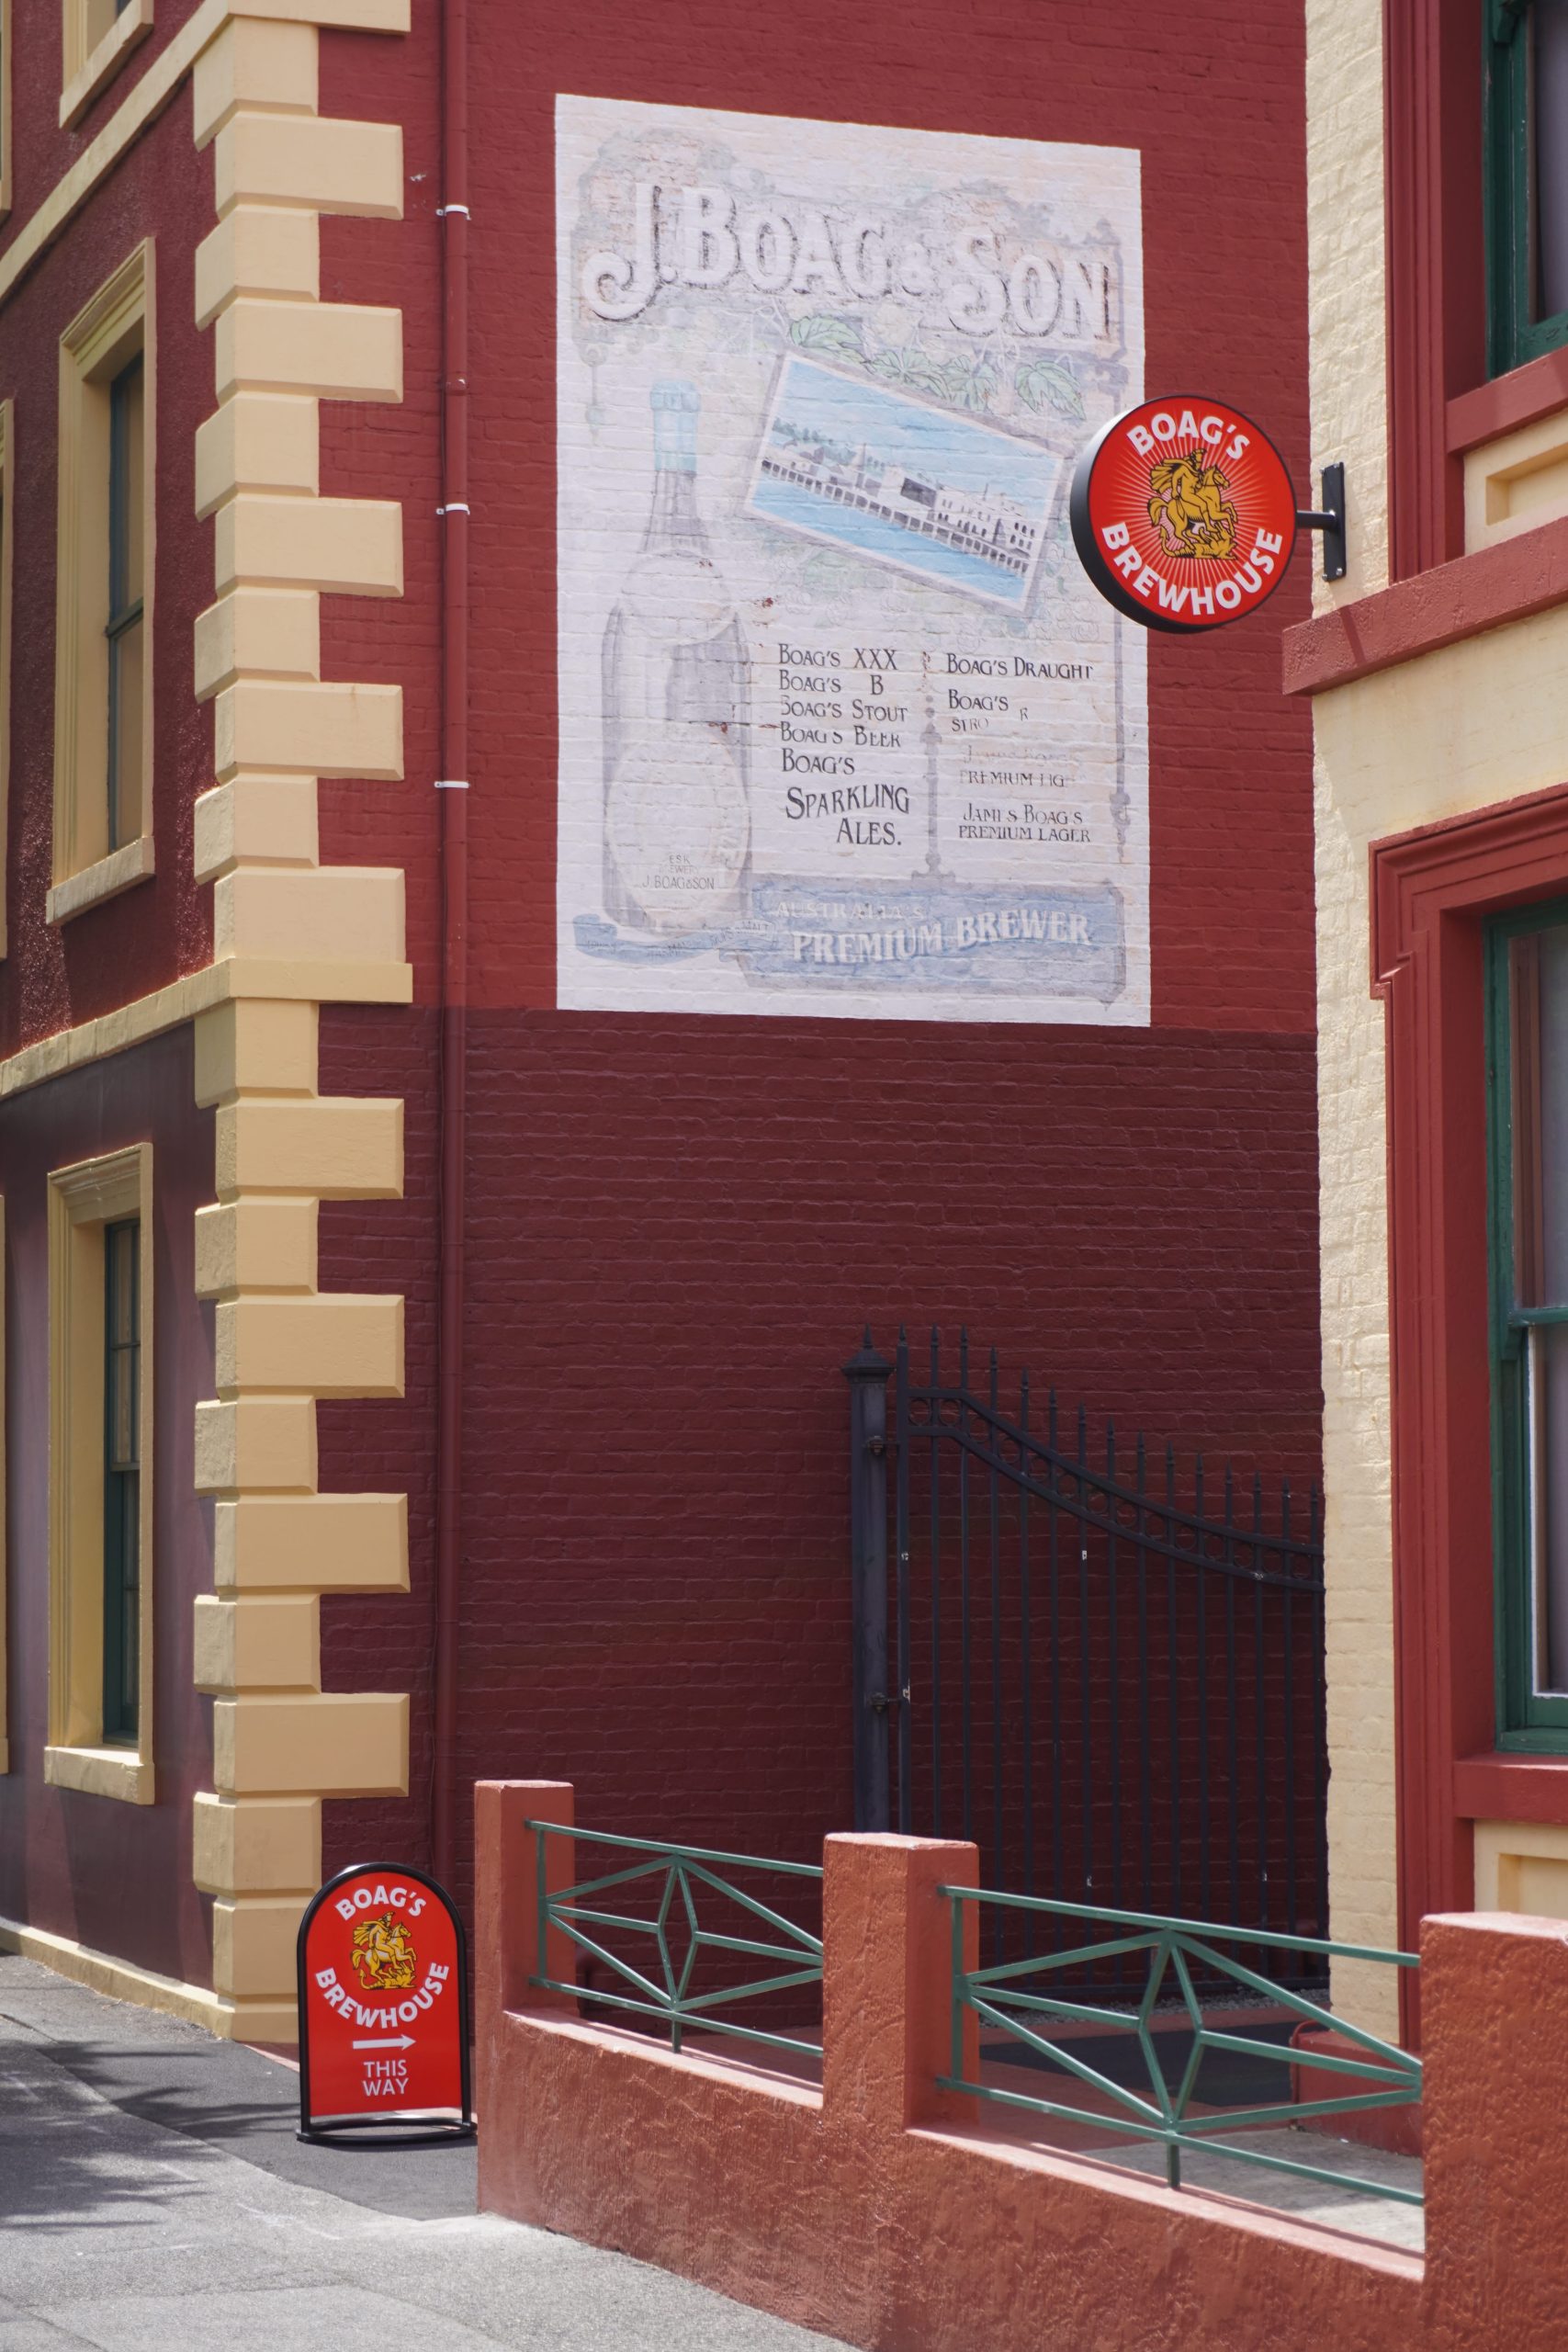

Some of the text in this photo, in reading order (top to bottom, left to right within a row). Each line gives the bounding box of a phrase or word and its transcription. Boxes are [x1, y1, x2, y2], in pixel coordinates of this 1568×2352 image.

[680, 186, 891, 300] BOAG
[895, 242, 931, 298] &
[946, 227, 1110, 338] SON
[1126, 411, 1250, 459] BOAG'S
[1102, 522, 1282, 615] BREWHOUSE
[779, 643, 898, 670] BOAG'S XXX
[947, 653, 1093, 679] BOAG'S DRAUGHT
[779, 670, 884, 695] BOAG'S B
[852, 699, 908, 722] STOUT
[948, 689, 1009, 711] BOAG'S
[854, 725, 901, 747] BEER
[782, 748, 855, 775] BOAG'S
[786, 784, 909, 820] SPARKLING
[837, 818, 902, 845] ALES.
[958, 825, 1091, 842] PREMIUM LAGER
[791, 909, 1091, 964] PREMIUM BREWER
[335, 1885, 426, 1921] BOAG'S
[315, 1962, 449, 2029] BREWHOUSE
[363, 2059, 407, 2078] THIS
[363, 2078, 409, 2097] WAY
